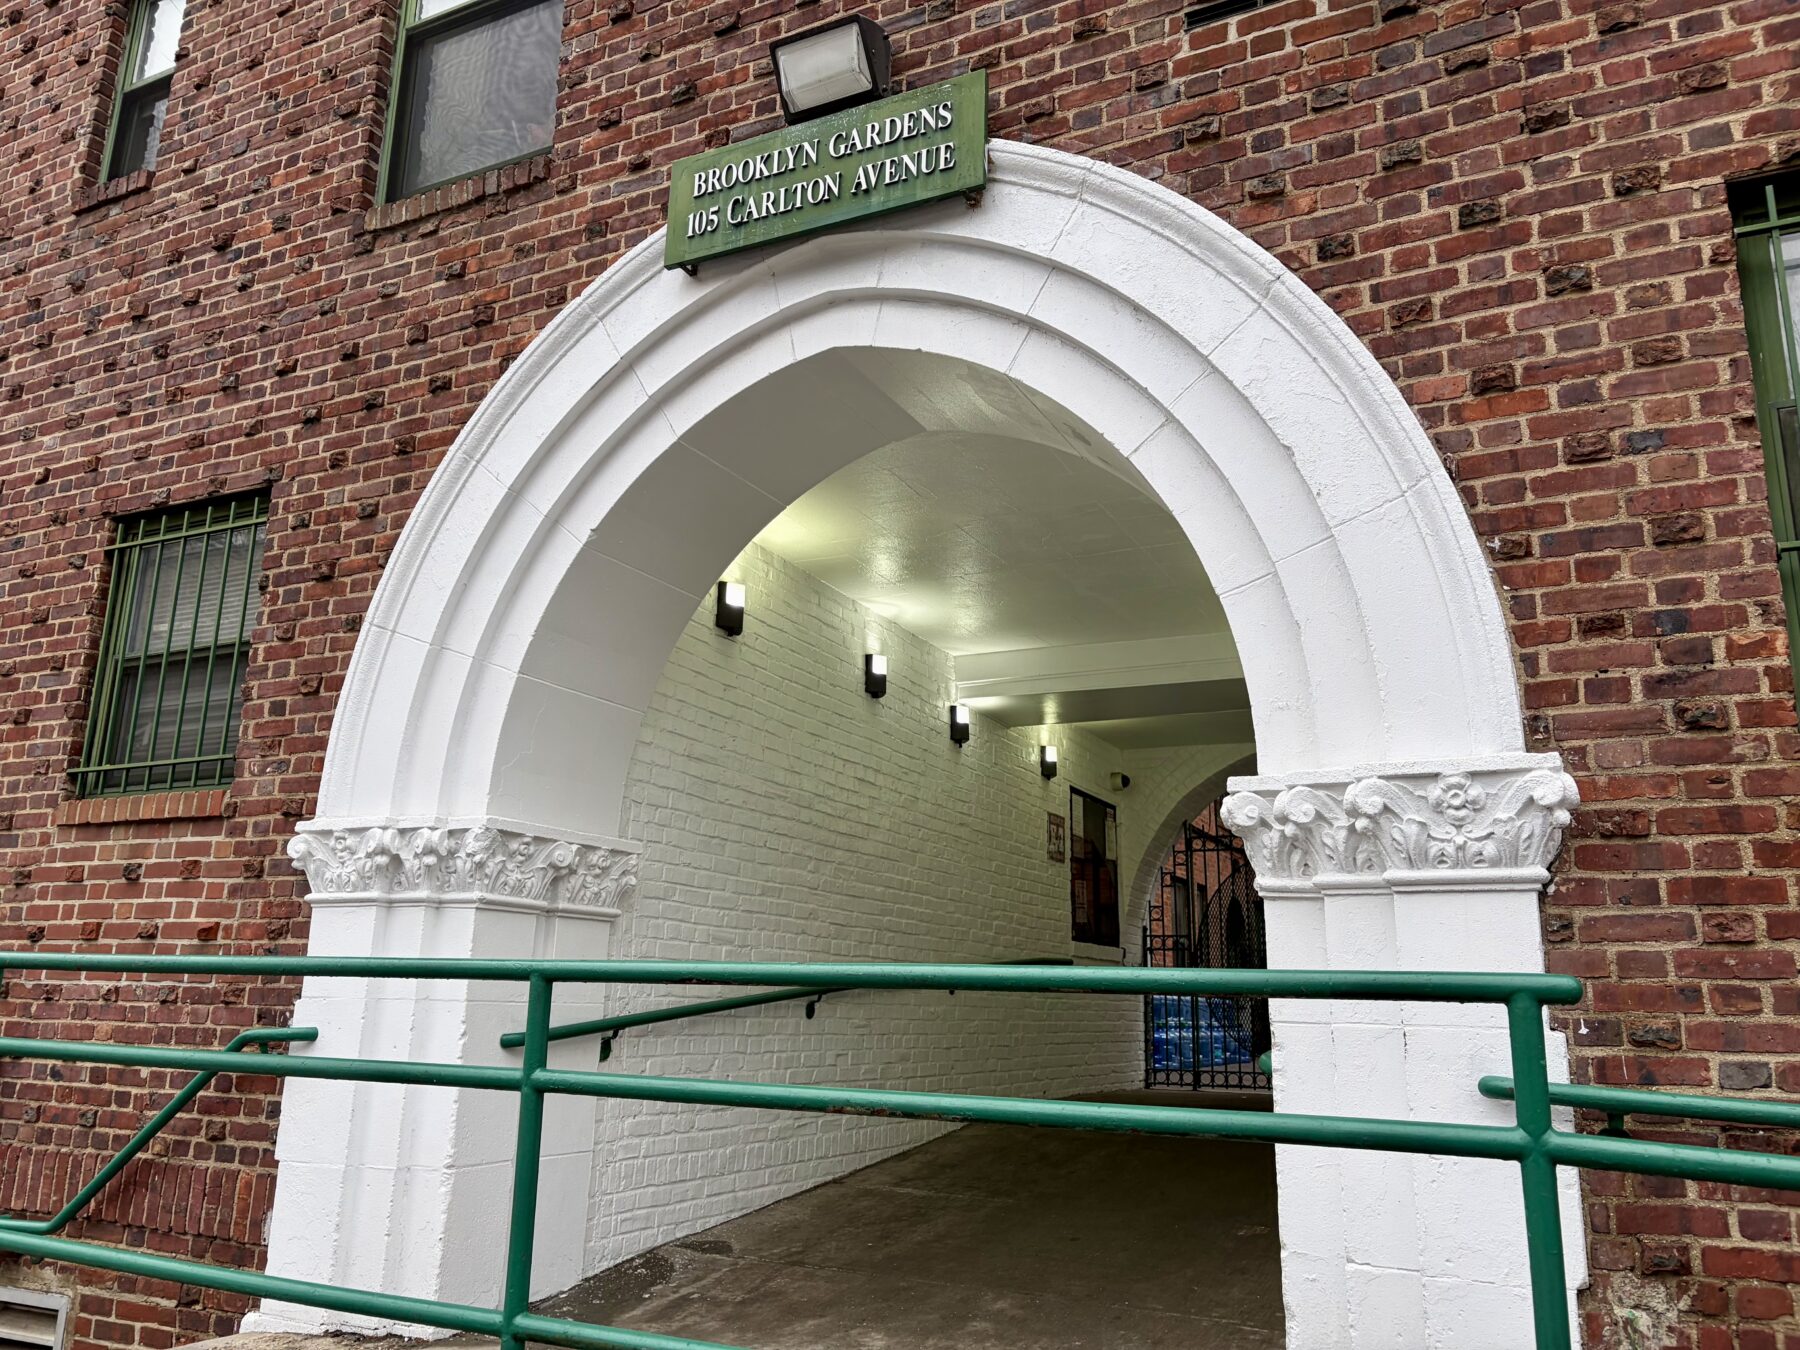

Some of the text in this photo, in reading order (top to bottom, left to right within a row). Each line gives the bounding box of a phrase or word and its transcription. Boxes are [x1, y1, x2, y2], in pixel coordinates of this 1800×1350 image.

[686, 141, 956, 238] 105 CARLTON AVENUE
[693, 101, 952, 198] BROOKLYN GARDENS
